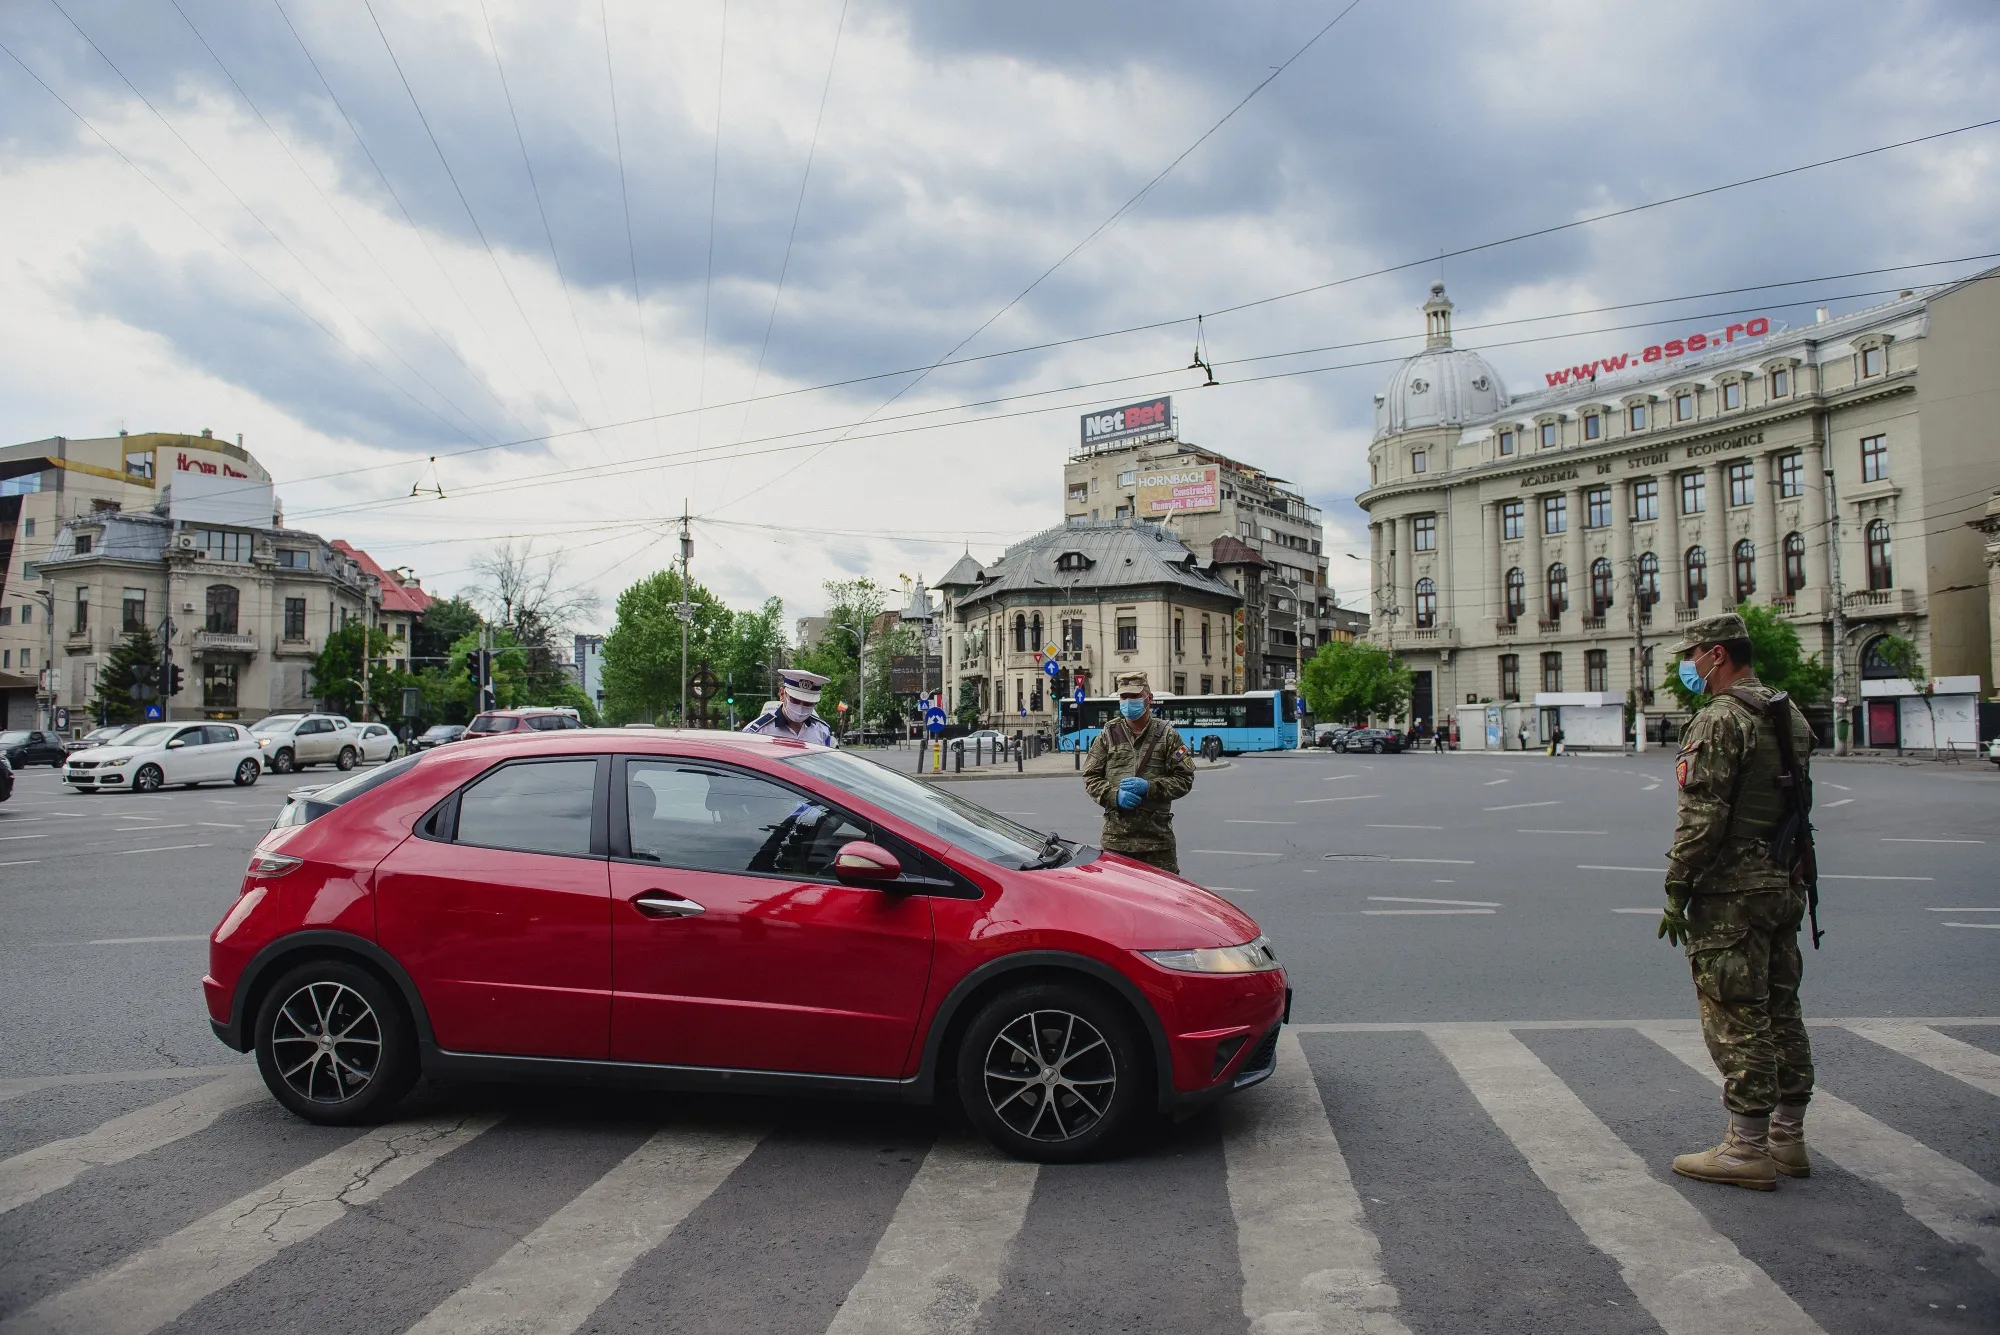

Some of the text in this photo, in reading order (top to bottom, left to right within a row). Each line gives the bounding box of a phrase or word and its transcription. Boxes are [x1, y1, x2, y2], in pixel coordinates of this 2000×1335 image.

[1545, 317, 1769, 387] www.ase.ro
[1086, 401, 1165, 437] NetBet
[1138, 471, 1205, 487] HORNBACH
[1520, 432, 1765, 488] ACADEMIA DE STUDII ECONOMICE
